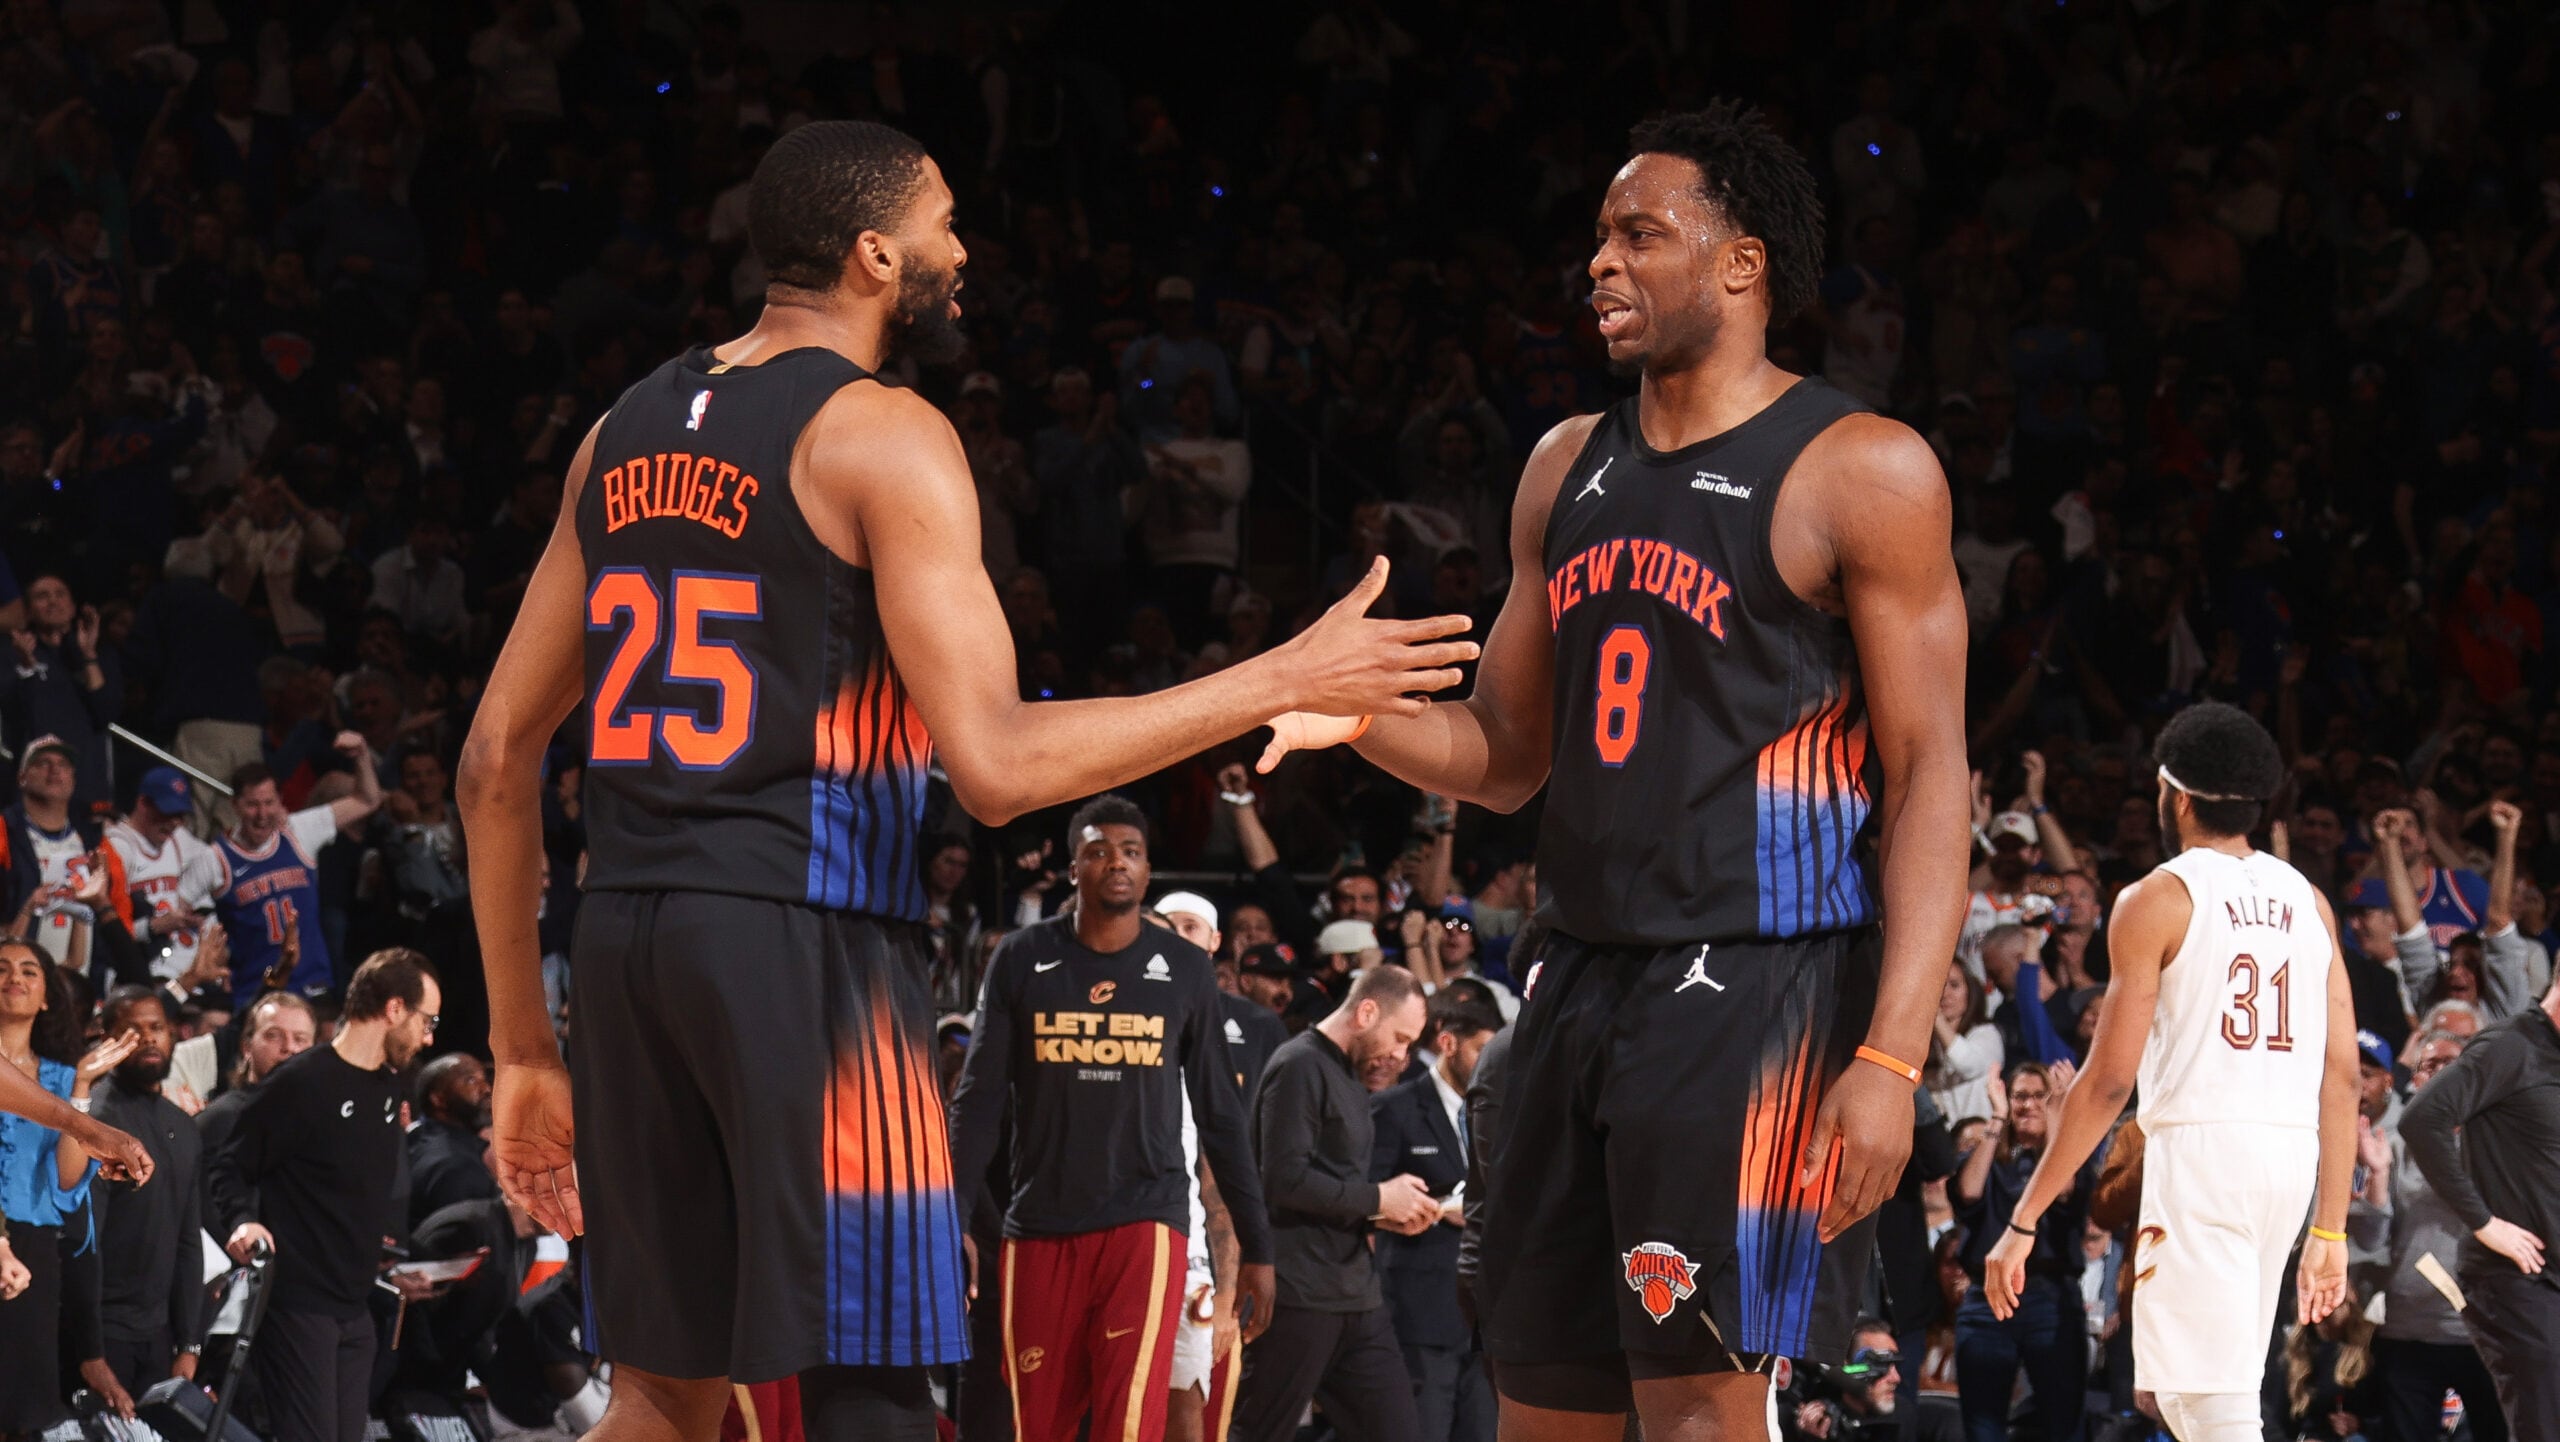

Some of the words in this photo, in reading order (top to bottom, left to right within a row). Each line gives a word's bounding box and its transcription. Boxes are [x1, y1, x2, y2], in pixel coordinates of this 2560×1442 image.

[603, 452, 760, 539] BRIDGES
[1691, 478, 1715, 492] abu
[1715, 482, 1753, 499] dhabi
[1547, 537, 1626, 636] NEW
[1627, 537, 1733, 648] YORK
[586, 566, 763, 771] 25
[1595, 623, 1653, 769] 8
[2225, 895, 2293, 934] ALLEN
[1033, 1011, 1105, 1037] LET
[1108, 1012, 1166, 1039] EM
[2221, 953, 2294, 1052] 31
[1034, 1037, 1164, 1067] KNOW.
[1628, 1249, 1694, 1289] KNICKS
